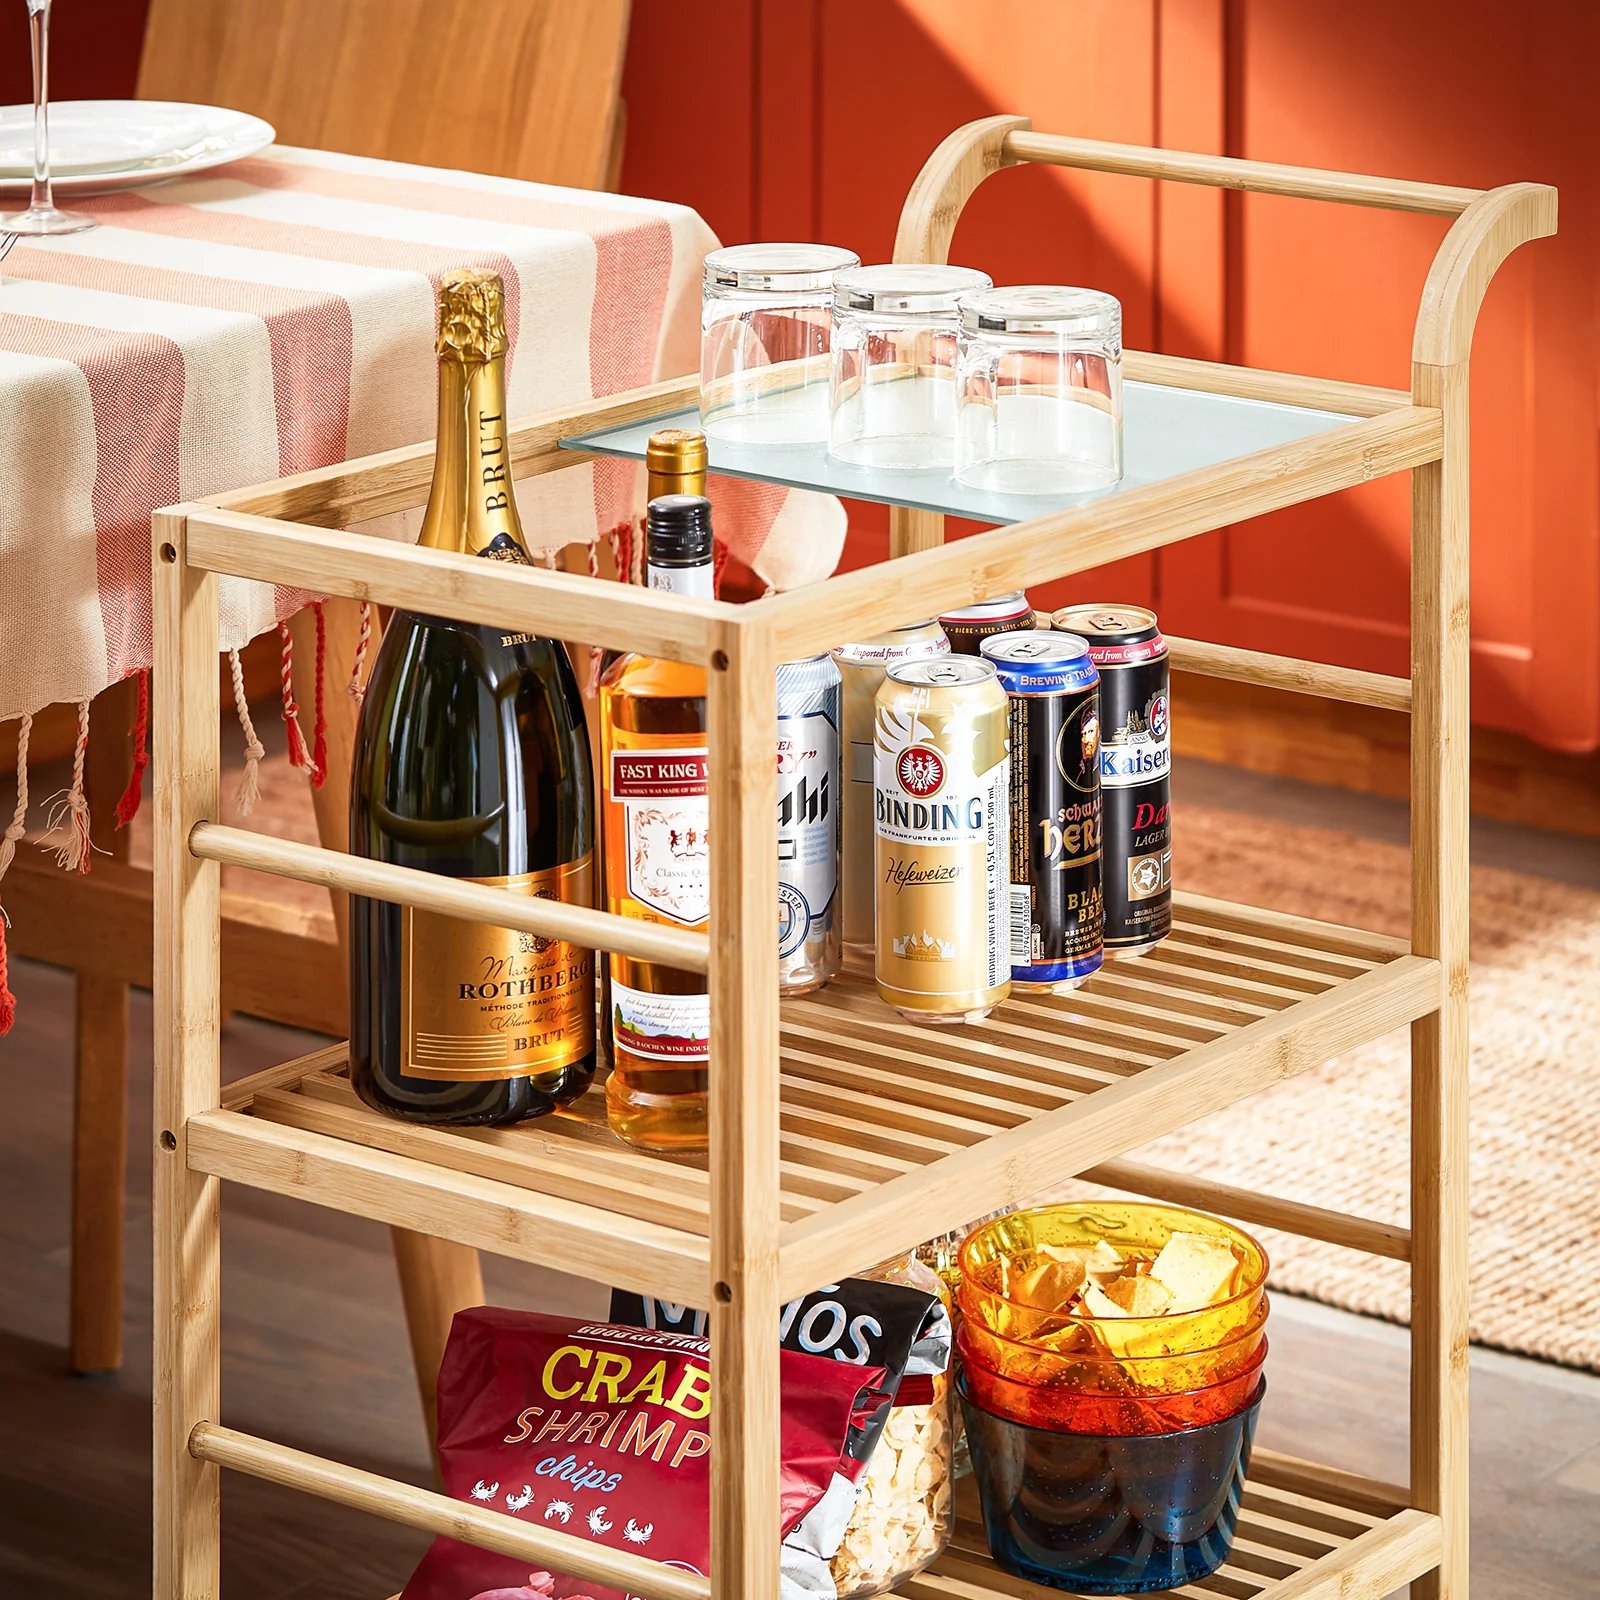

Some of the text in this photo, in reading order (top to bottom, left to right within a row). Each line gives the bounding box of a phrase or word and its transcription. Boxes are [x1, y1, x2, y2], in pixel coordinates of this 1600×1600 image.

[479, 411, 509, 514] BRUT
[500, 632, 538, 648] BRUT
[853, 647, 885, 660] Imported
[885, 647, 904, 660] from
[1103, 650, 1123, 662] from
[1123, 648, 1151, 659] Germany
[1020, 674, 1073, 686] BREWING
[1130, 733, 1149, 744] ANNO
[619, 764, 654, 779] FAST
[657, 763, 698, 778] KING
[885, 788, 900, 796] SEIT
[876, 787, 984, 832] BINDING
[987, 801, 995, 819] 500
[888, 830, 939, 841] FRANKFURTER
[987, 821, 995, 846] CONT
[1134, 830, 1164, 848] LAGER
[986, 848, 996, 872] 0,5L
[656, 867, 689, 877] Classic
[885, 856, 965, 896] Hefeweizen
[988, 887, 996, 911] BEER
[988, 914, 996, 946] WHEAT
[1064, 925, 1093, 938] BREWED
[1064, 942, 1091, 954] GERMAN
[479, 946, 581, 980] Marquis de
[988, 947, 996, 986] BINDING
[458, 959, 589, 1000] ROTHBERG
[480, 984, 584, 1012] MÉTHODE TRADITIONNELLE
[652, 1002, 675, 1012] whisky
[489, 1012, 532, 1033] Blanc
[533, 1013, 544, 1024] de
[648, 1021, 670, 1031] strong
[672, 1011, 691, 1024] from
[514, 1028, 565, 1051] BRUT
[666, 1044, 685, 1052] WINE
[541, 1345, 711, 1420] CRAB
[503, 1406, 712, 1468] SHRIMP
[535, 1454, 623, 1492] chips
